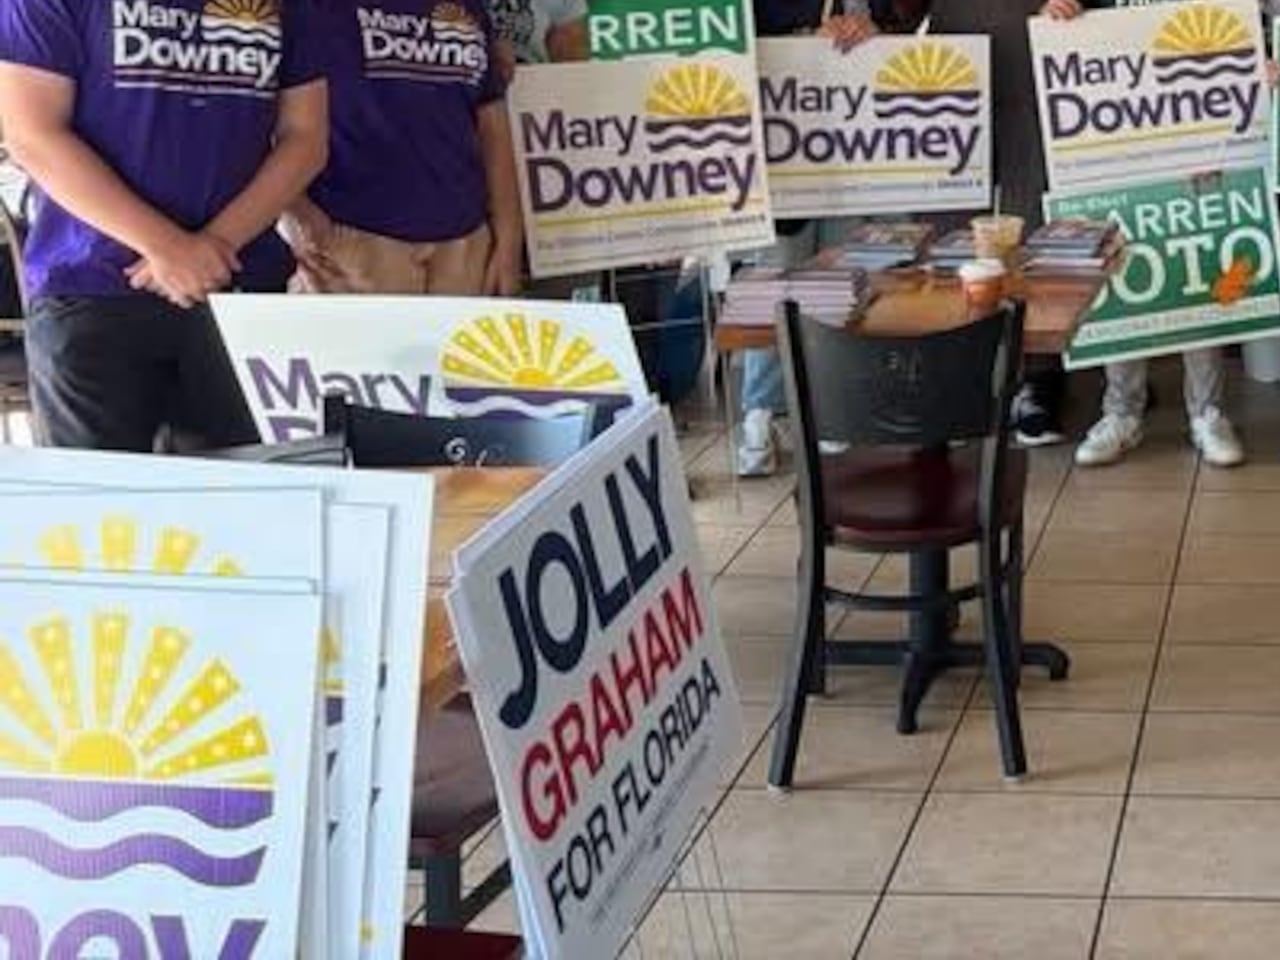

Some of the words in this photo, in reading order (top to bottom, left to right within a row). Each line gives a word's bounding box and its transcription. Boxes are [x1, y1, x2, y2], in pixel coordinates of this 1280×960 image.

[357, 6, 428, 36] Mary
[588, 5, 739, 52] RREN
[114, 27, 281, 88] Downey
[1043, 52, 1146, 89] Mary
[760, 77, 867, 120] Mary
[1048, 82, 1260, 139] Downey
[520, 110, 637, 156] Mary
[764, 118, 981, 175] Downey
[526, 152, 755, 214] Downey
[1104, 189, 1264, 242] ARREN
[1090, 227, 1273, 310] OTO
[247, 358, 432, 418] Mary
[498, 435, 672, 730] JOLLY
[521, 566, 704, 842] GRAHAM
[546, 805, 611, 933] FOR
[612, 658, 721, 833] FLORIDA
